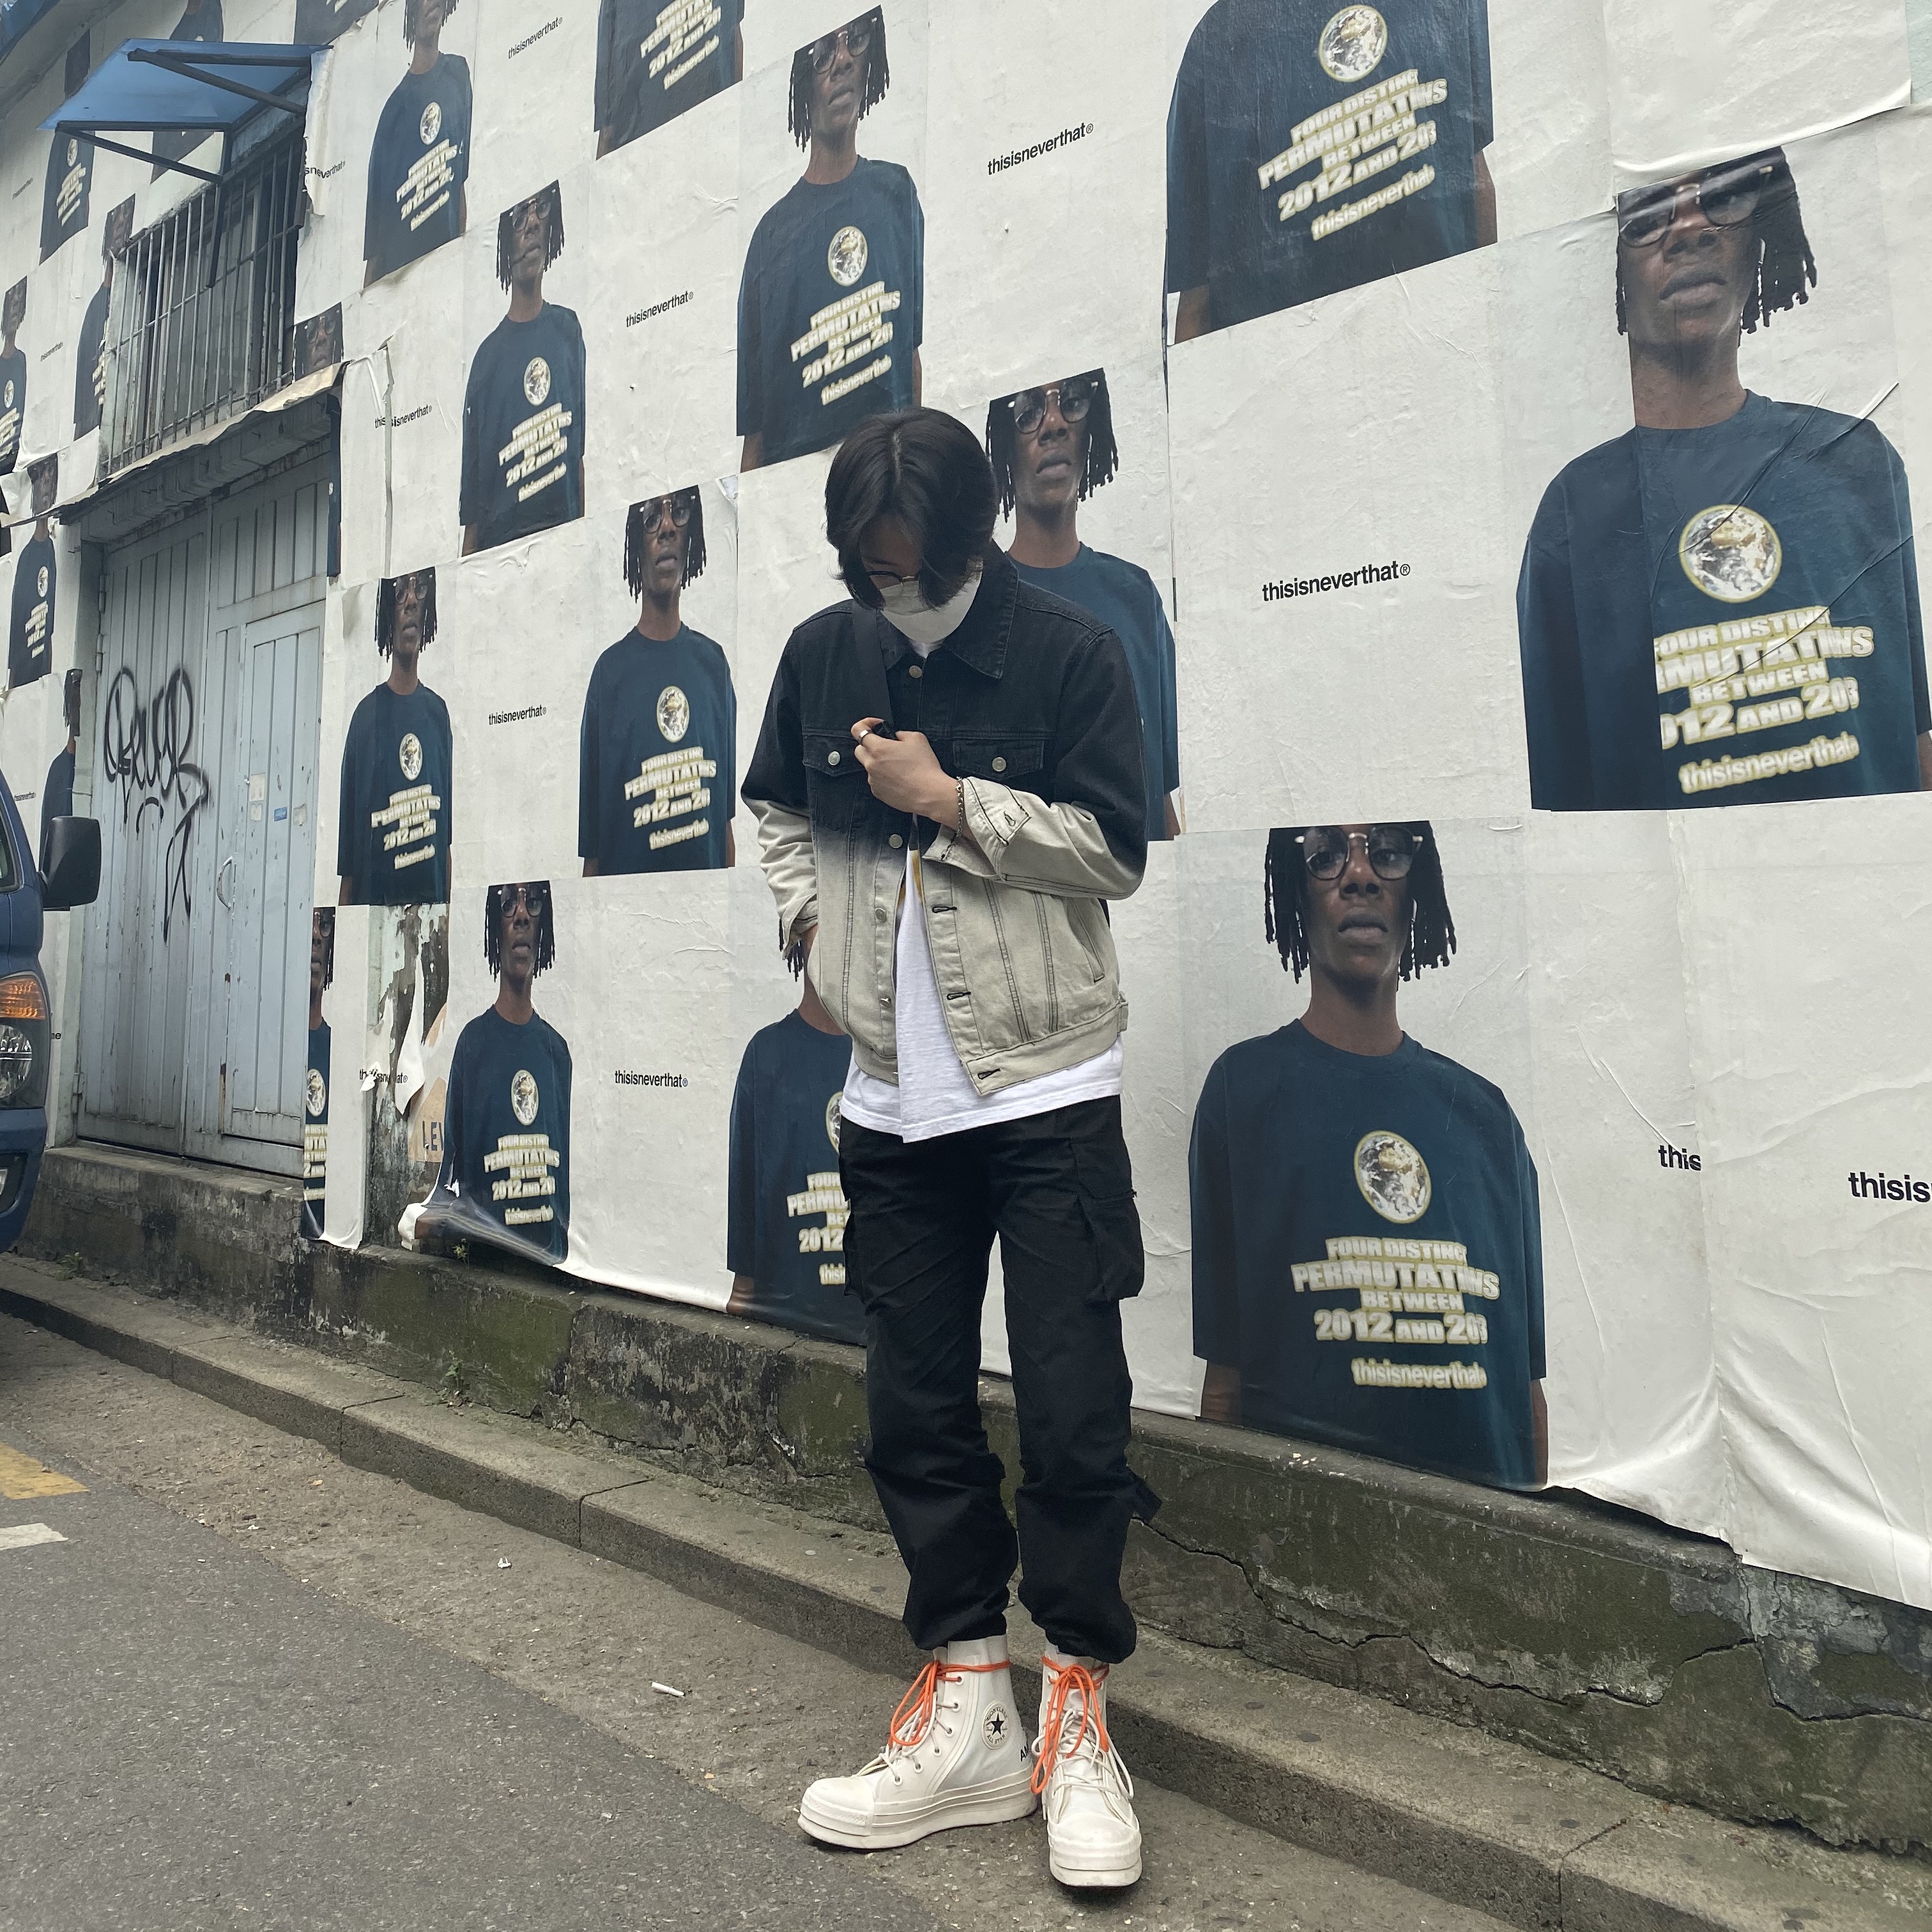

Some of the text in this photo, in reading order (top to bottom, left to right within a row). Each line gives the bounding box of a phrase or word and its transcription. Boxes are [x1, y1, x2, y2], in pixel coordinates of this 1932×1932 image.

[1291, 102, 1344, 146] FOUR
[1322, 111, 1416, 172] BETWEEN
[1278, 162, 1353, 221] 2012
[1353, 145, 1399, 185] AND
[828, 314, 882, 353] BETWEEN
[802, 348, 845, 388] 2012
[845, 337, 871, 365] AND
[1689, 661, 1829, 708] BETWEEN
[1736, 696, 1804, 733] AND
[634, 799, 670, 828] 2012
[670, 797, 692, 816] AND
[492, 1179, 522, 1201] 2012
[807, 1172, 841, 1191] FOUR
[1848, 1171, 1932, 1203] thisis
[799, 1226, 845, 1253] 2012
[1326, 1236, 1382, 1260] FOUR
[1360, 1289, 1466, 1314] BETWEEN
[1314, 1308, 1395, 1342] 2012
[1395, 1319, 1446, 1344] AND
